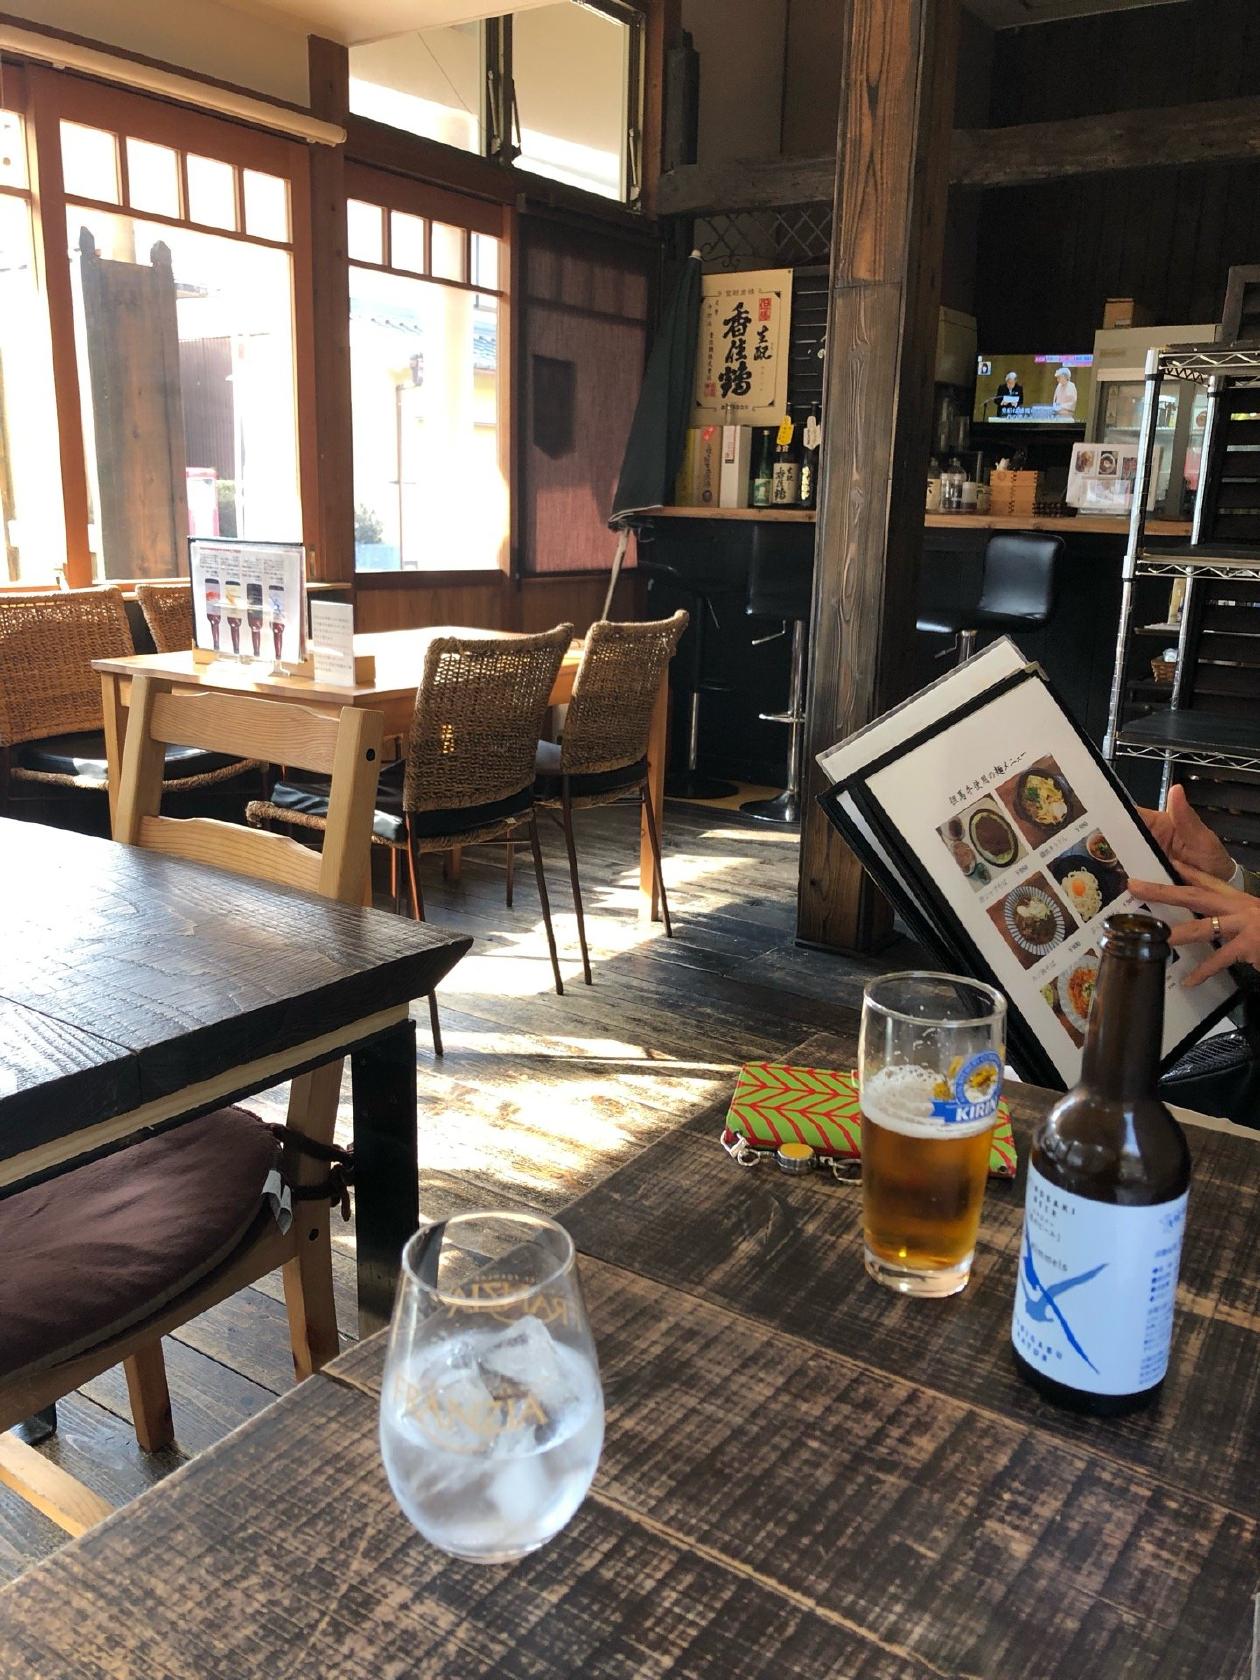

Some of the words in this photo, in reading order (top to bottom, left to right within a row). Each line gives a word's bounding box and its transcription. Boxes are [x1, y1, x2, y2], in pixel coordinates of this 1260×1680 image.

[717, 301, 752, 399] 香住鶴
[955, 1097, 998, 1122] KIRIN
